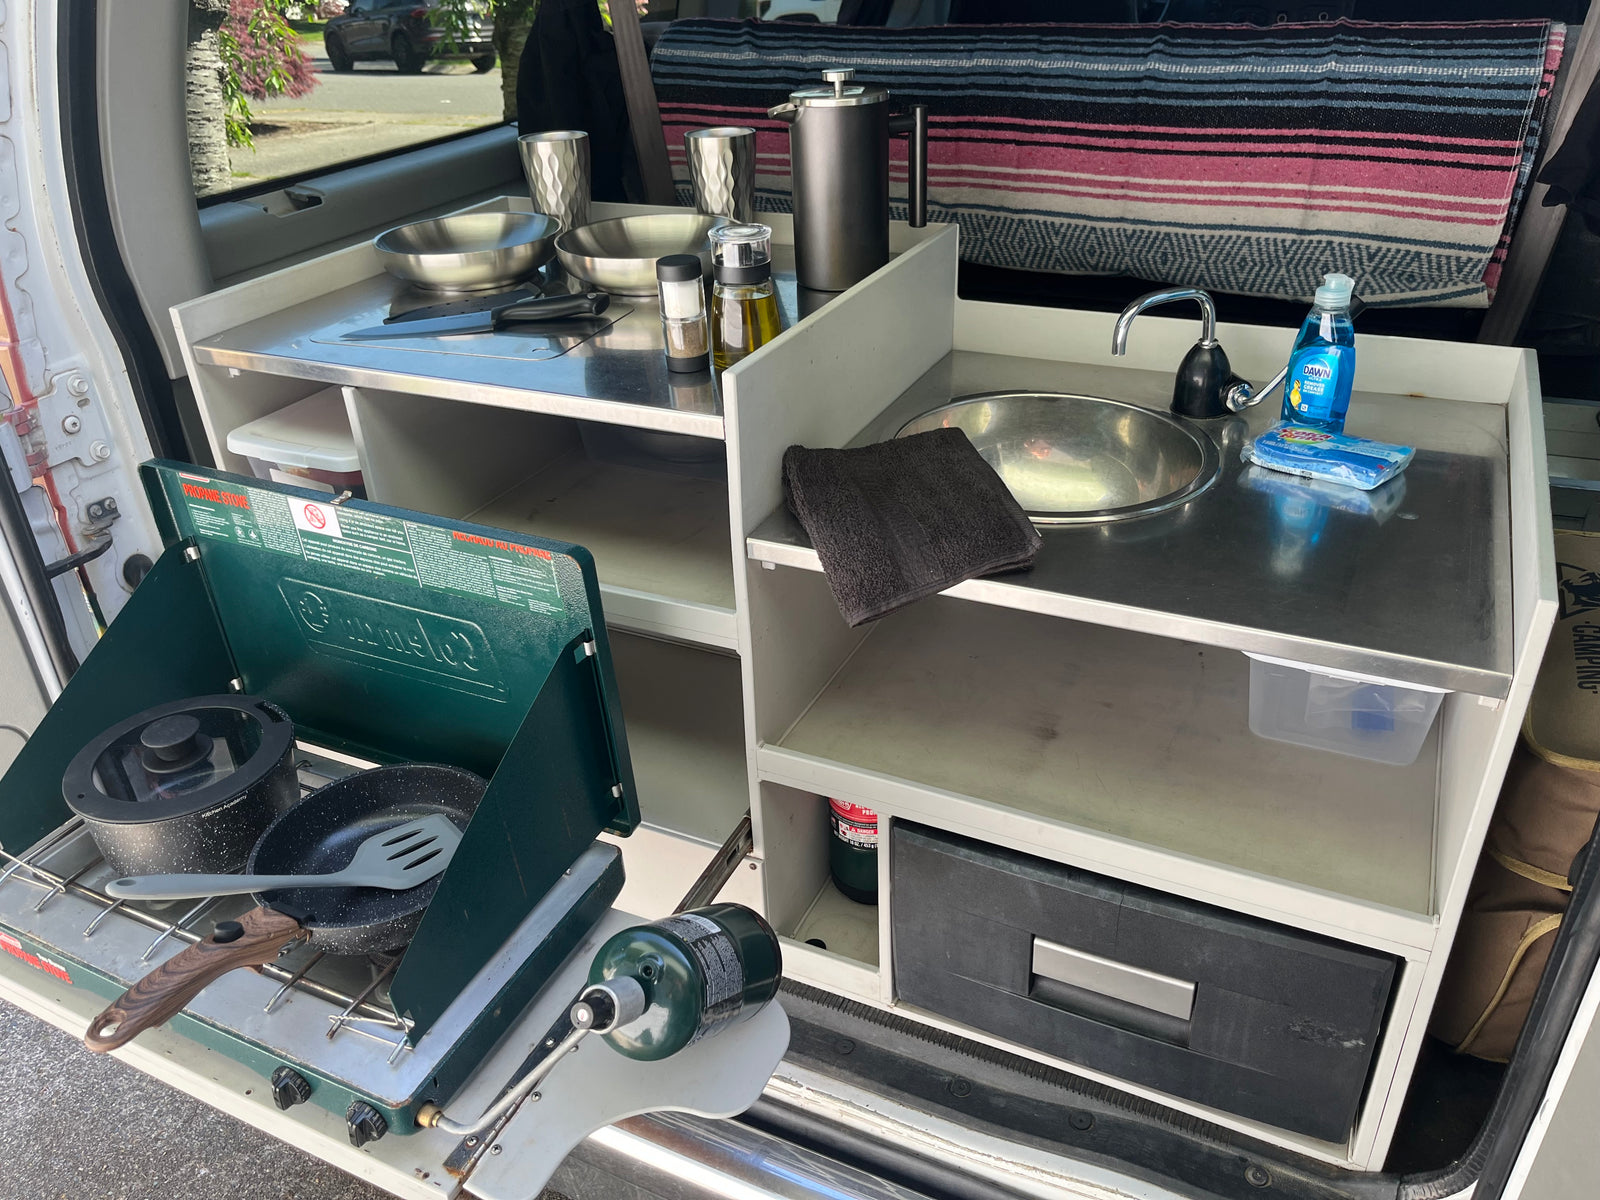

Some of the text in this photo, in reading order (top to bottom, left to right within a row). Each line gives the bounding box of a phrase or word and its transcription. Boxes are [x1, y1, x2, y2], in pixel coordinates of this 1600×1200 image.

[1303, 365, 1331, 379] DAWN
[182, 483, 250, 510] PROPANE STOVE
[202, 795, 247, 819] Kitchen Academy
